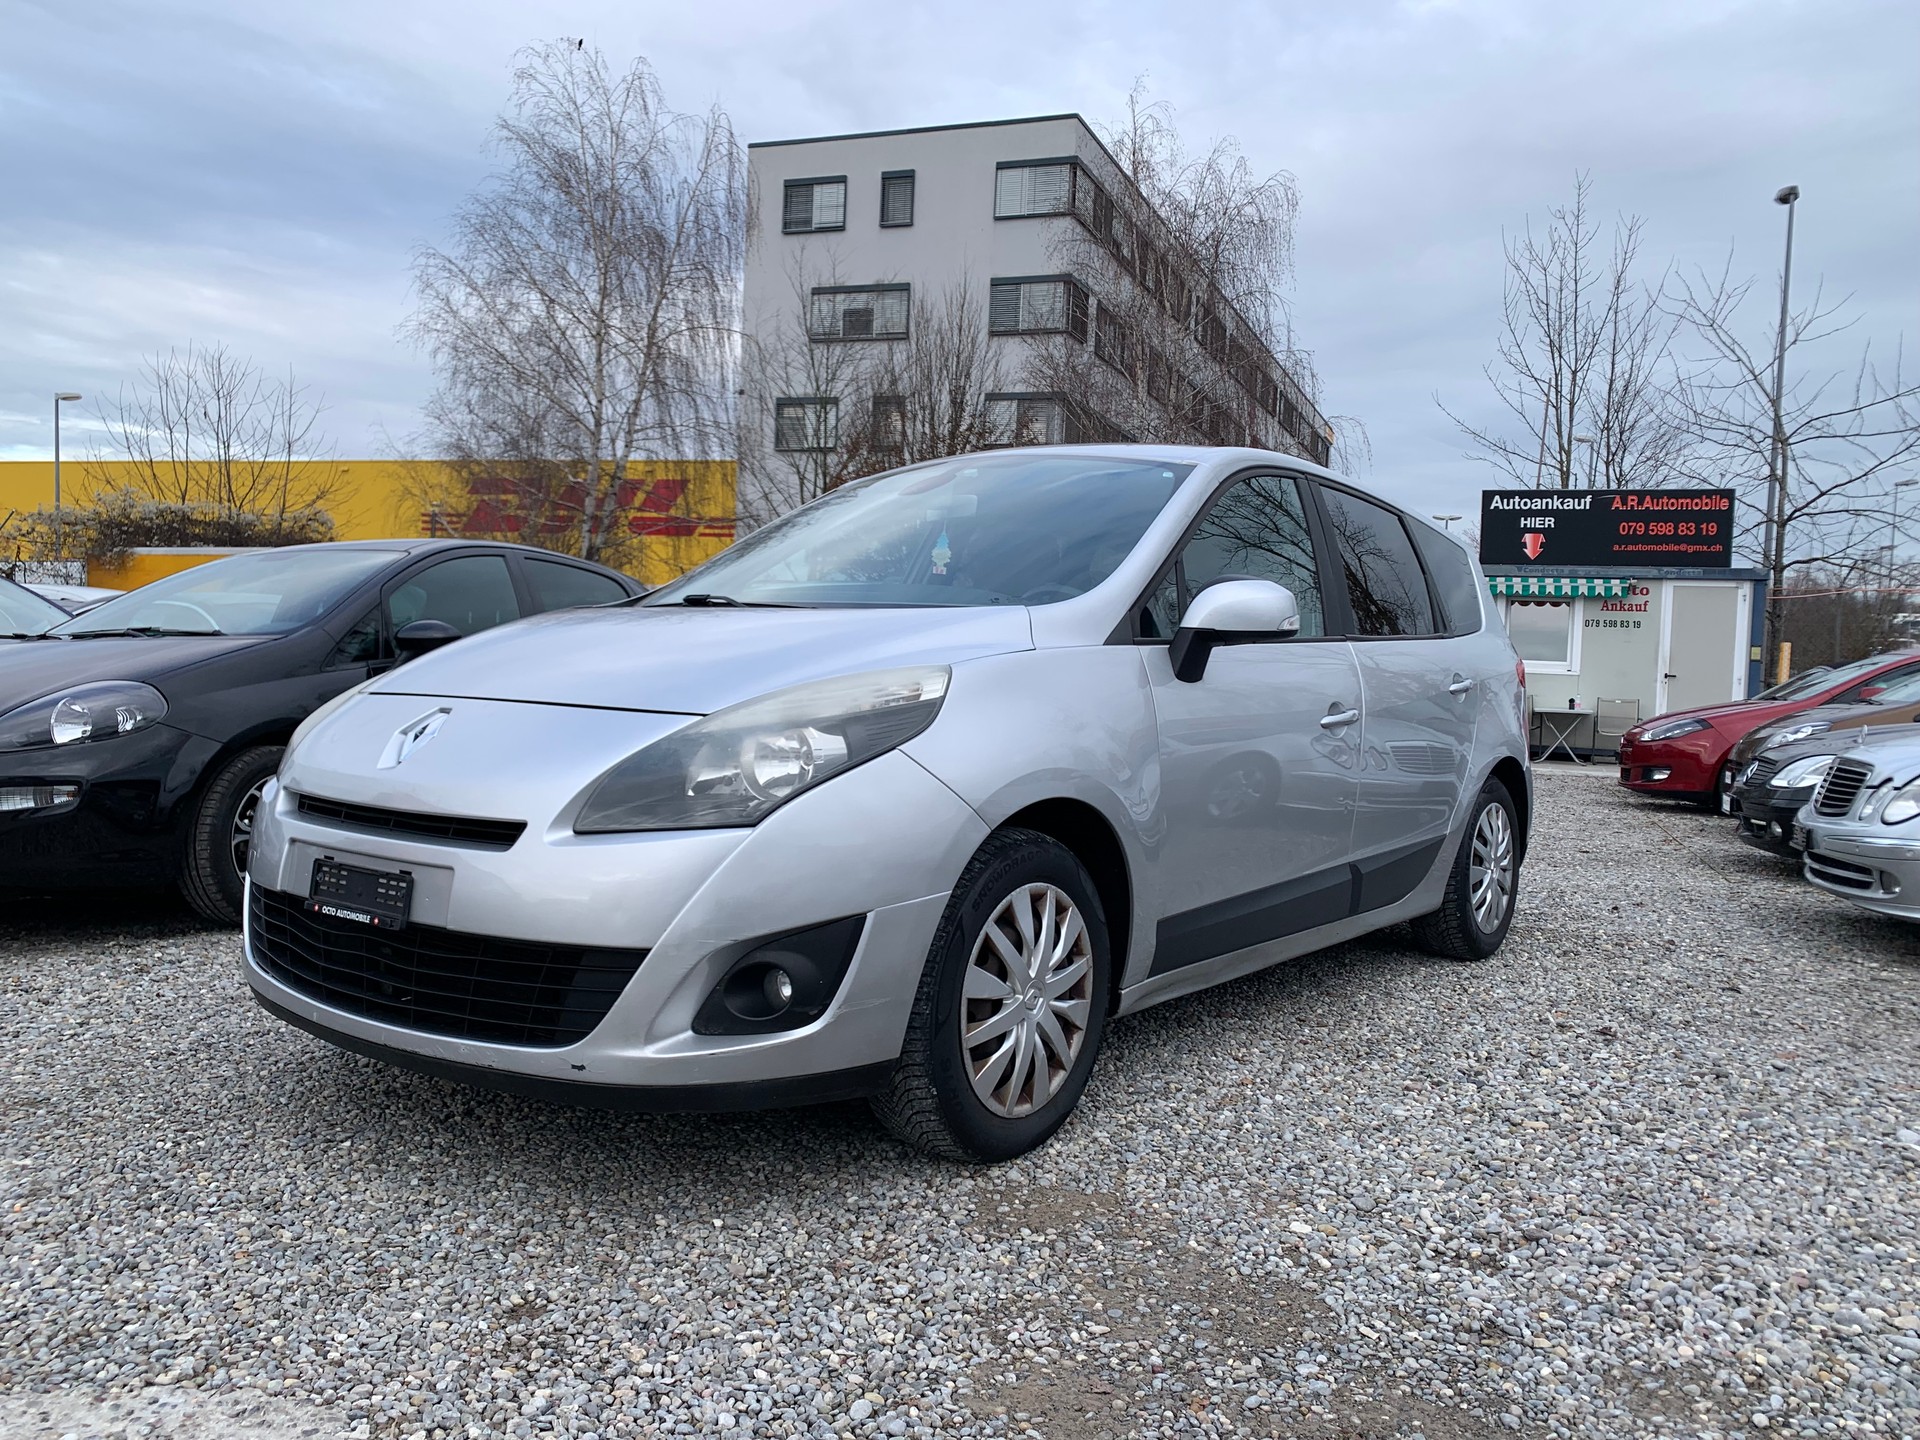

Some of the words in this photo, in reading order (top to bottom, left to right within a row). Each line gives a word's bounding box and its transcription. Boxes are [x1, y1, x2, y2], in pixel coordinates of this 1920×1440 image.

[1490, 494, 1592, 510] Autoankauf
[1611, 494, 1730, 510] A.R.Automobile
[1520, 517, 1555, 528] HIER
[1619, 522, 1645, 535] 079
[1649, 522, 1676, 535] 598
[1678, 522, 1696, 535] 83
[1701, 522, 1718, 535] 19
[1612, 543, 1723, 553] a.r.automobile@gmx.ch
[1600, 600, 1650, 612] Ankauf
[1584, 619, 1601, 628] 079
[1603, 619, 1618, 628] 598
[1620, 620, 1630, 628] 83
[1633, 620, 1641, 629] 19
[322, 905, 336, 916] OCTO
[336, 909, 371, 923] AUTOMOBILE
